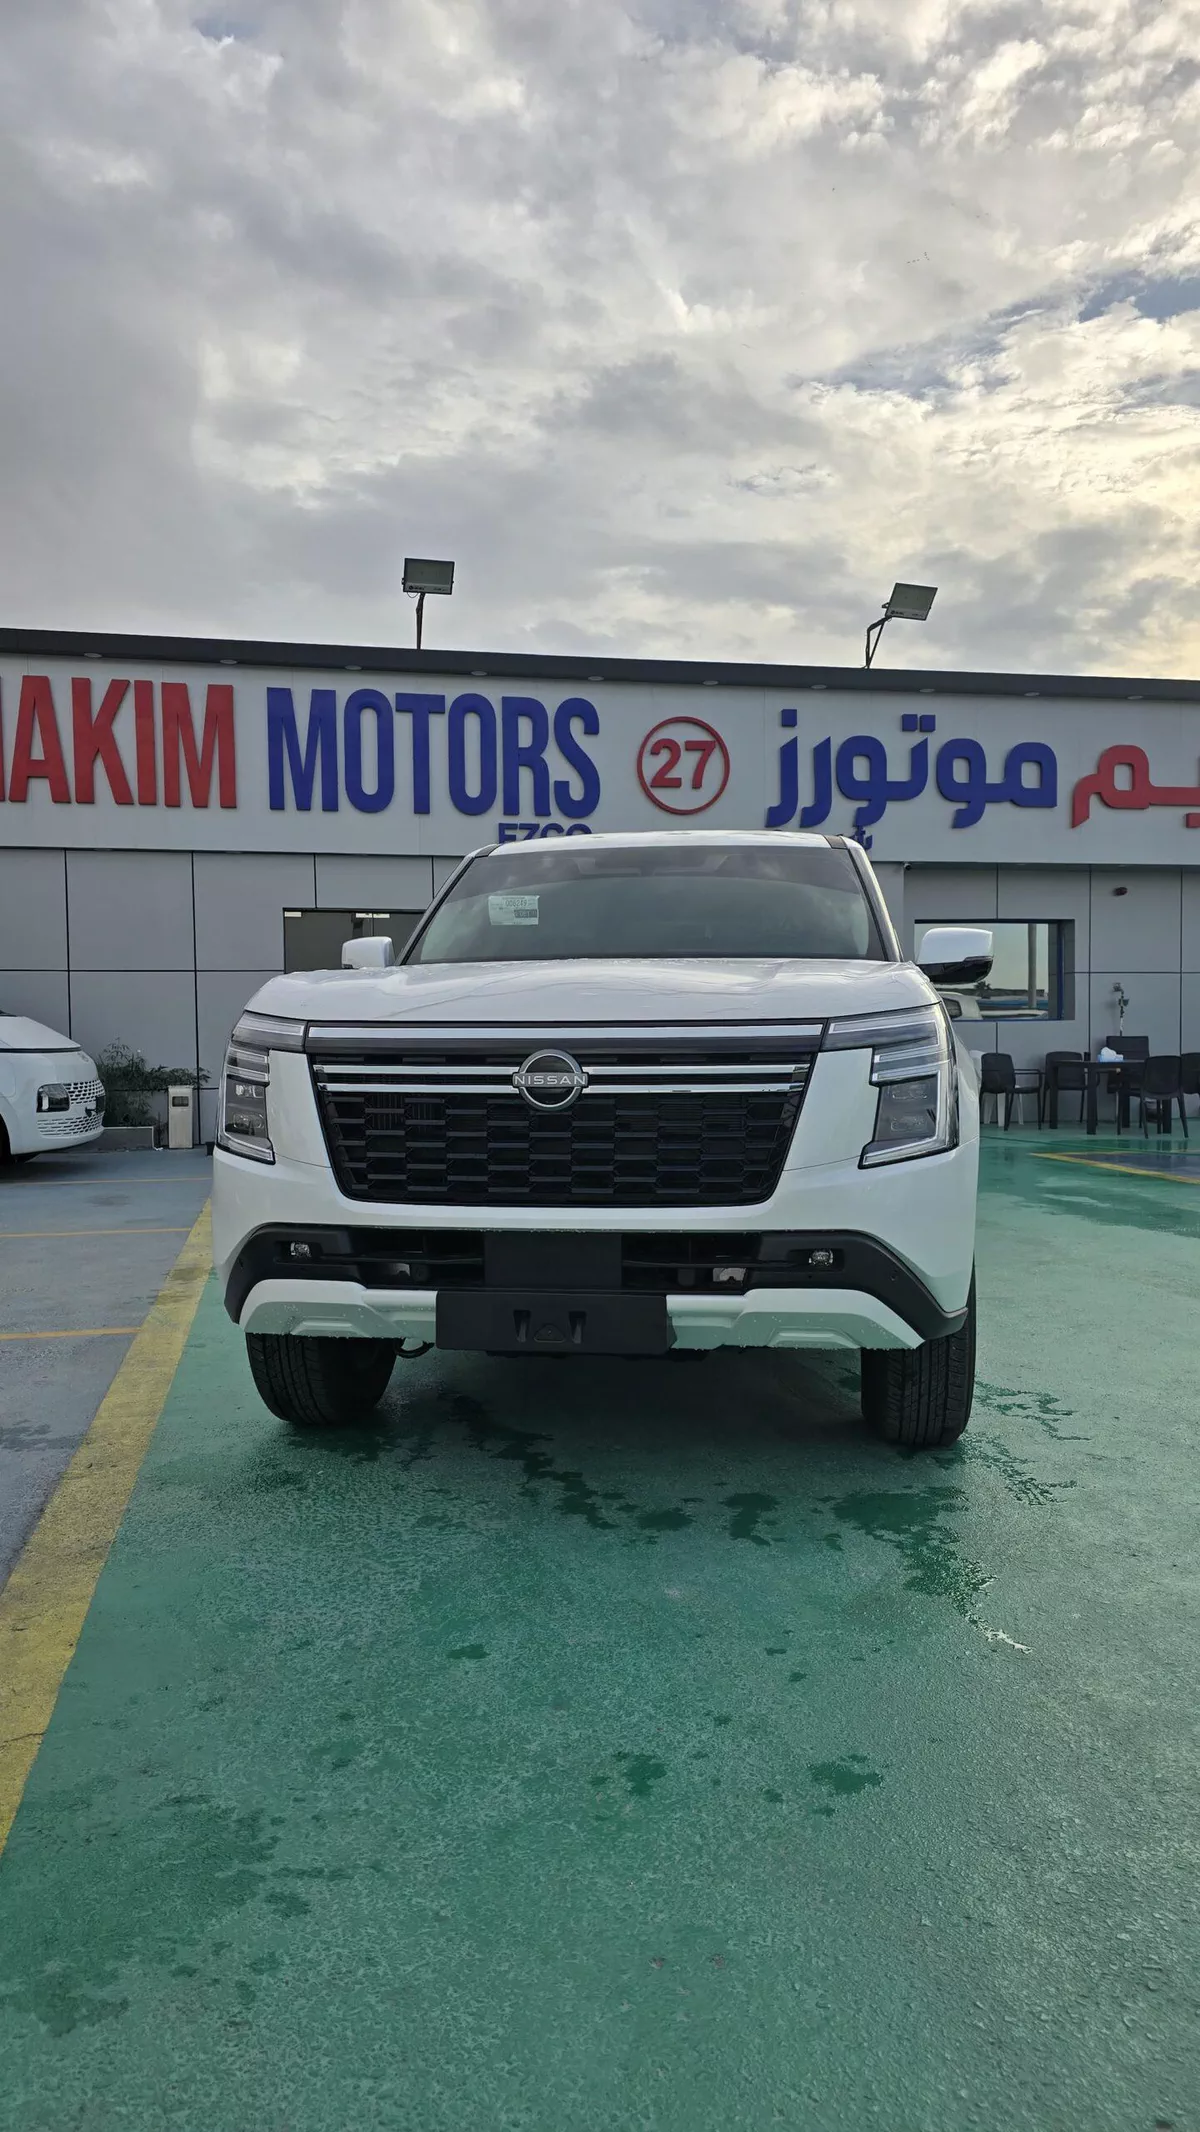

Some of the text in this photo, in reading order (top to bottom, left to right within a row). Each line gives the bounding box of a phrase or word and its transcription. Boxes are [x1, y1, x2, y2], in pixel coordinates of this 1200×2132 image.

[0, 674, 600, 819] AKIM MOTORS
[649, 738, 717, 789] 27
[765, 708, 1057, 829] موتورز
[514, 1075, 586, 1085] NISSAN
